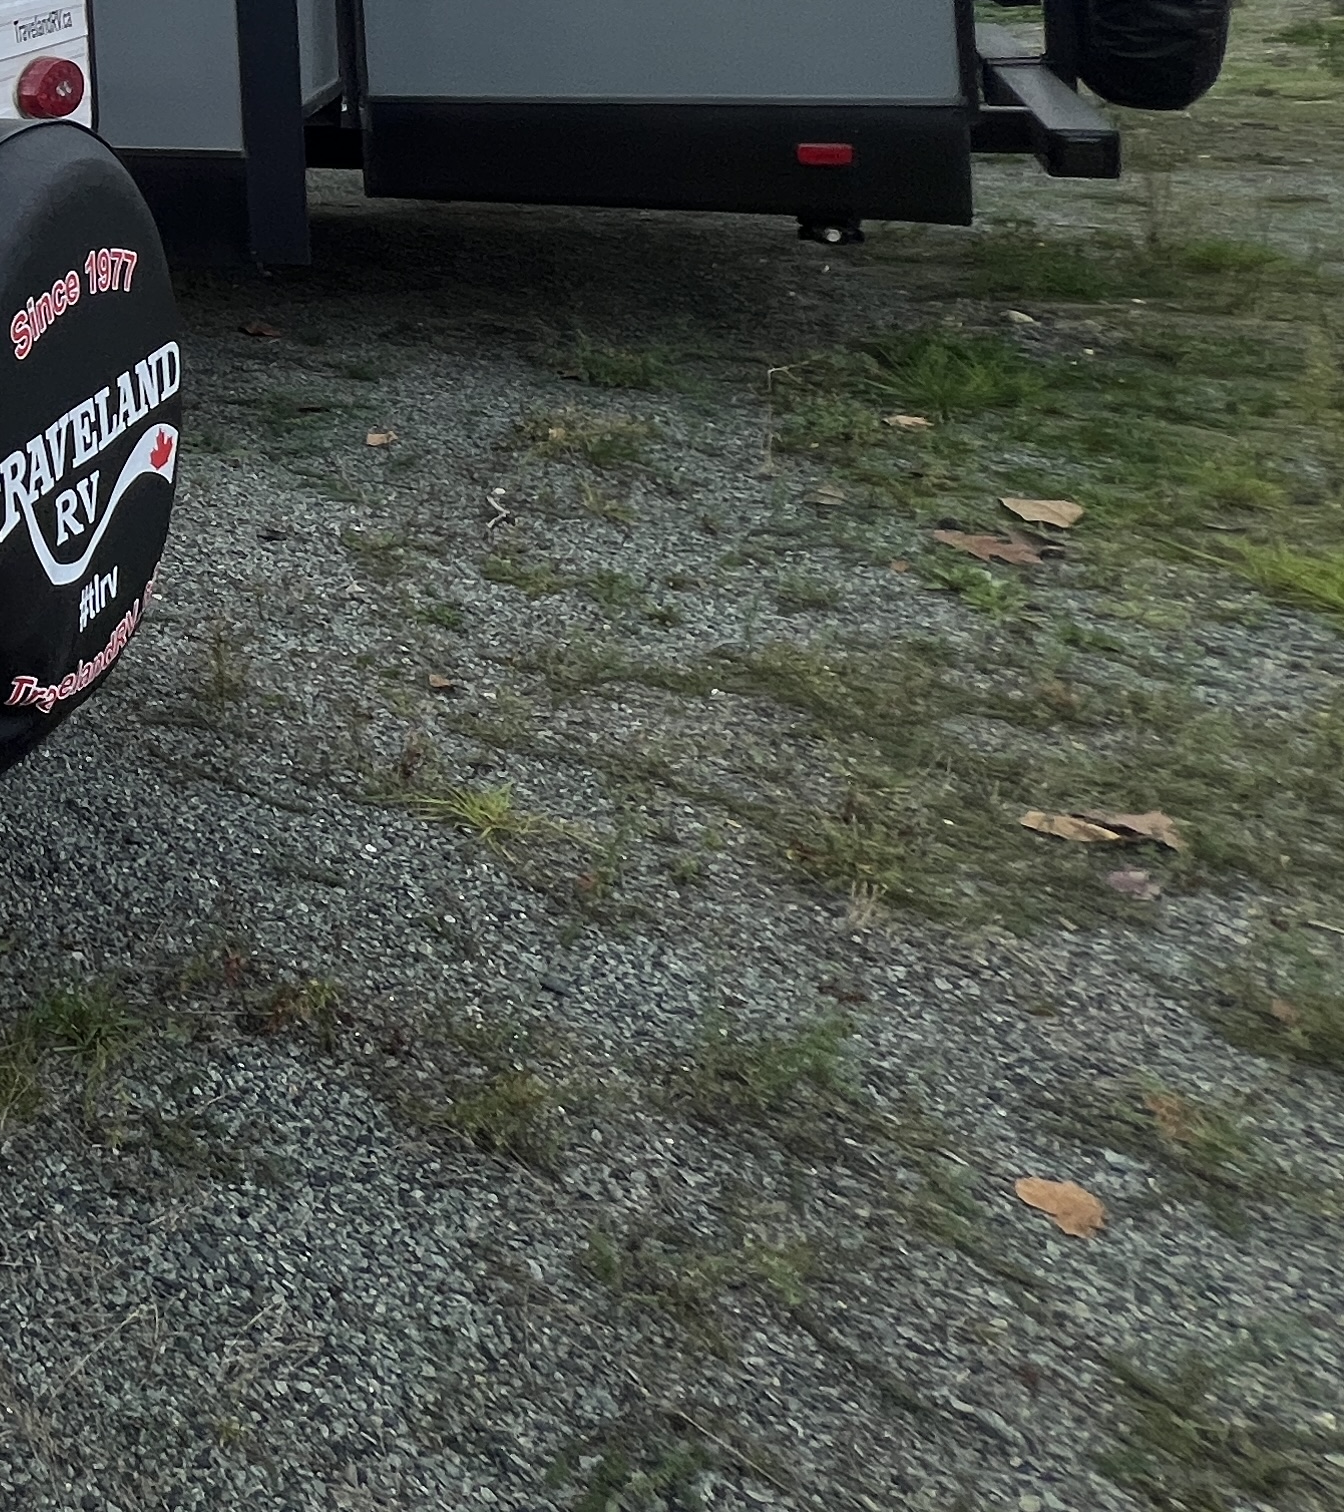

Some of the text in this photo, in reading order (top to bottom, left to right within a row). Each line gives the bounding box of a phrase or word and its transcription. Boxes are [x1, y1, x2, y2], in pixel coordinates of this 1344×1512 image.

[10, 247, 138, 360] Since 1977
[56, 470, 100, 546] RV
